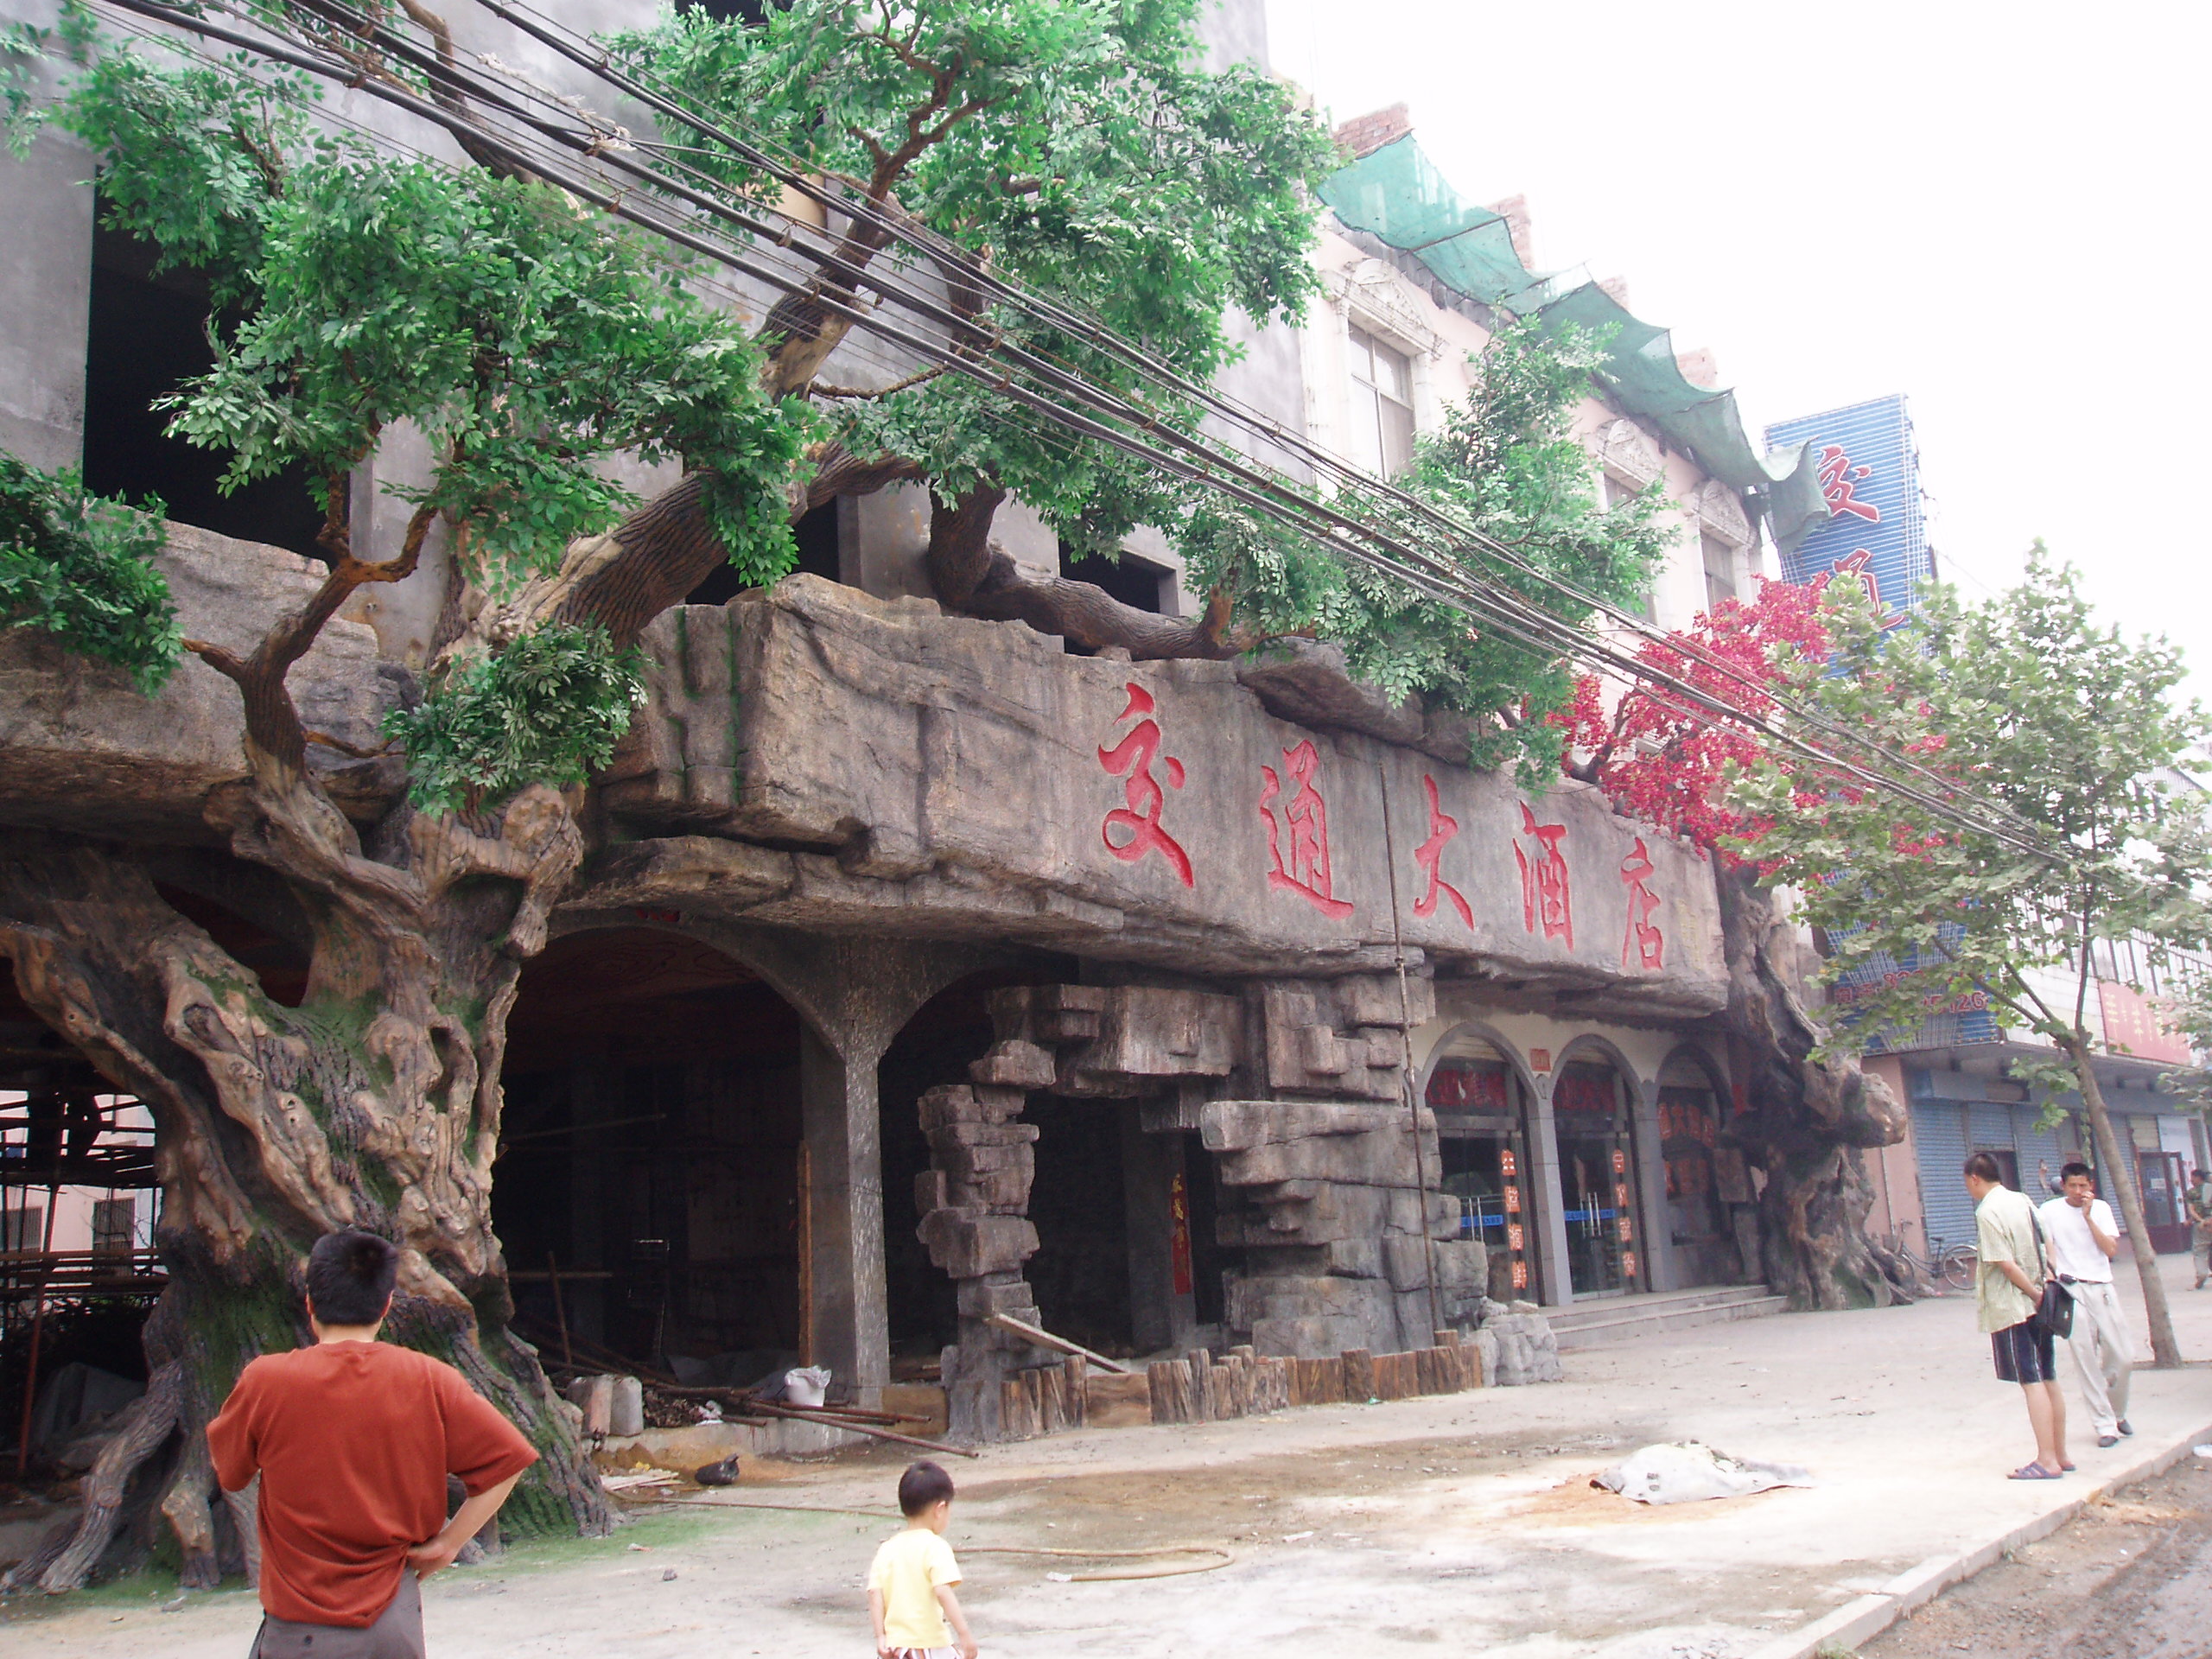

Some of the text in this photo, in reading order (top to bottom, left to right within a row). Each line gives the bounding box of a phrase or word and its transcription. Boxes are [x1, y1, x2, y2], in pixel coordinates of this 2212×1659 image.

[1097, 682, 1663, 969] 交通大酒店
